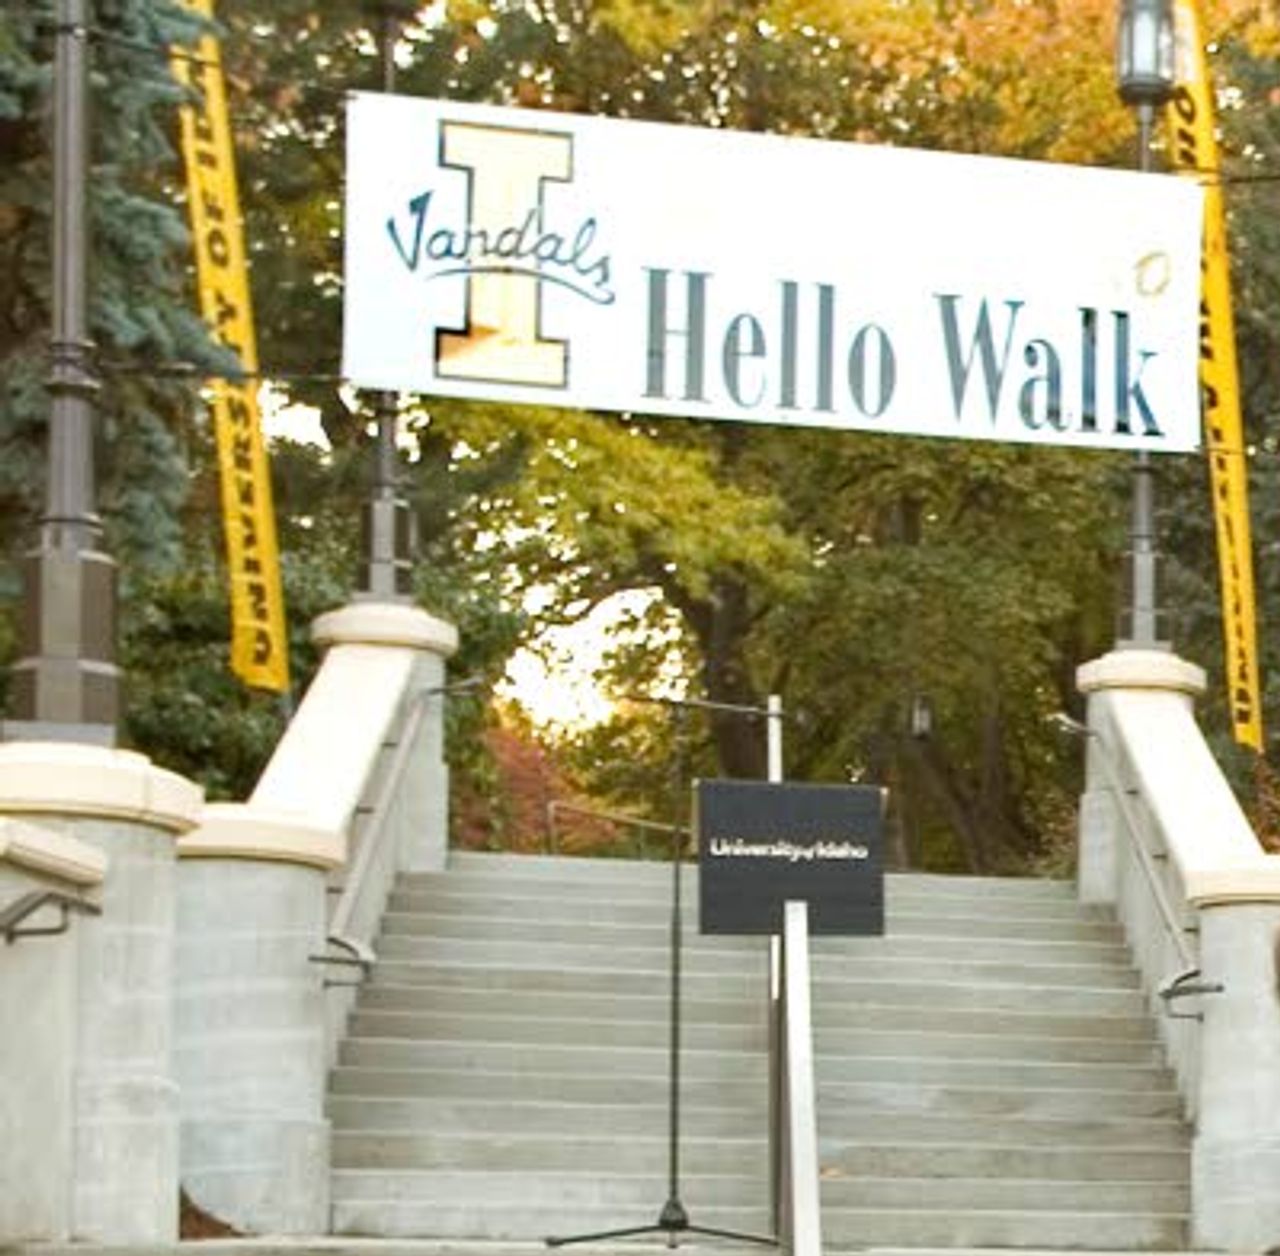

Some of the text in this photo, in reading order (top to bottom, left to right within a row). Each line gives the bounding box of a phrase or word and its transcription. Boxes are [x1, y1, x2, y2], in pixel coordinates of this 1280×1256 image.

[386, 189, 614, 292] Vandals
[640, 264, 1166, 440] Hello Walk
